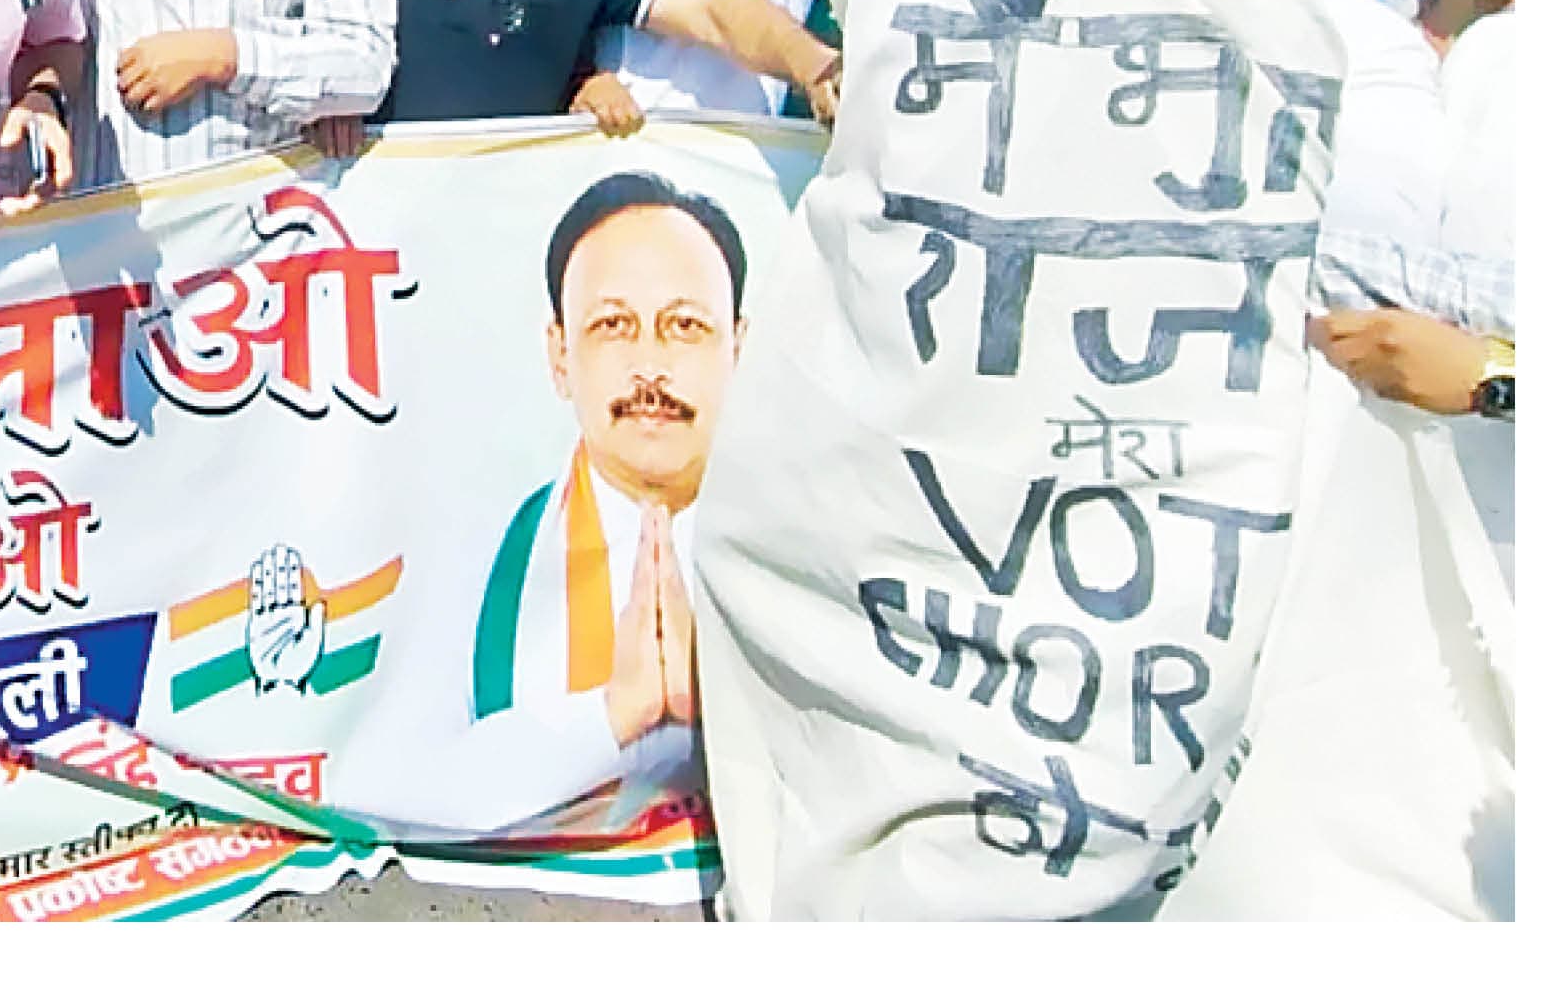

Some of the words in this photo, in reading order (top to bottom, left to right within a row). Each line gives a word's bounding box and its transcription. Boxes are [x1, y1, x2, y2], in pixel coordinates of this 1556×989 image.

[1044, 395, 1191, 480] मेरा
[902, 446, 1293, 641] VOT
[858, 576, 1212, 774] CHOR
